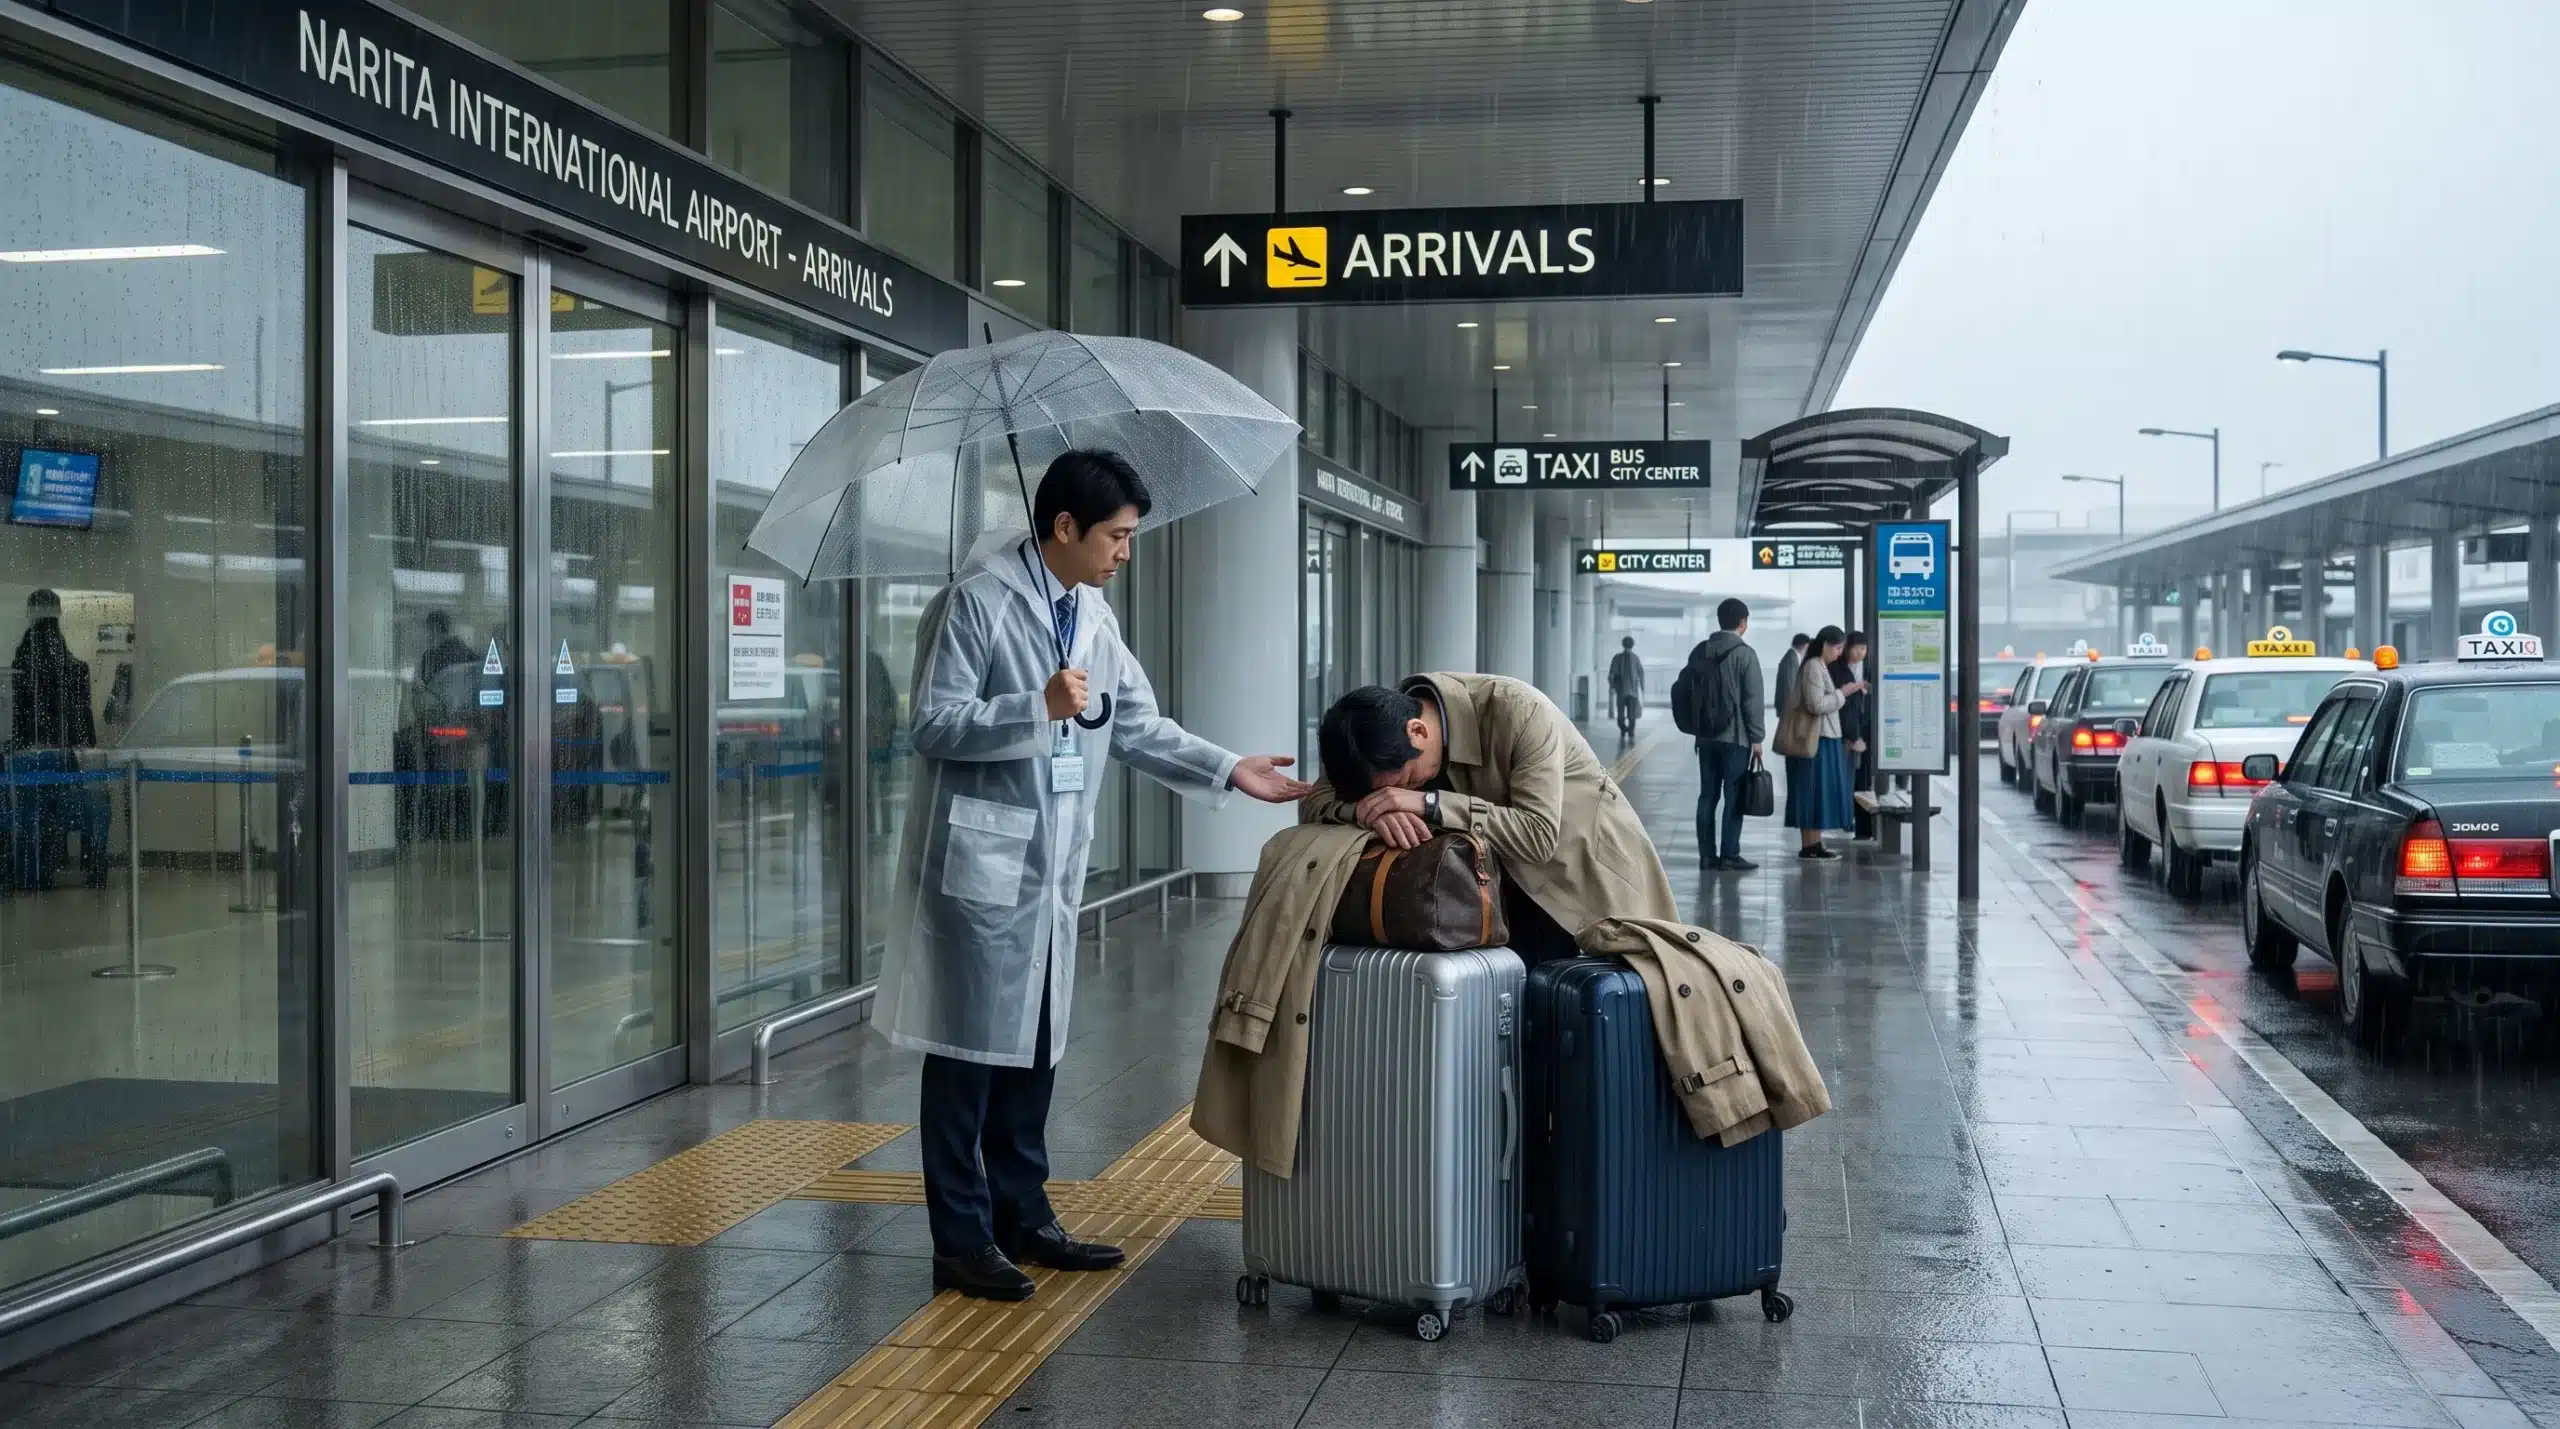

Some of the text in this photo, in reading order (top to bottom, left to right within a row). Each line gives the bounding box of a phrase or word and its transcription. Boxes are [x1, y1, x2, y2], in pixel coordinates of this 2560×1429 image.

[299, 9, 439, 129] NARITA
[450, 78, 680, 230] INTERNATIONAL
[685, 189, 783, 271] AIRPORT
[802, 242, 894, 318] ARRIVALS
[1342, 227, 1596, 279] ARRIVALS
[1533, 452, 1600, 480] TAXI
[1610, 448, 1645, 465] BUS
[1610, 466, 1700, 481] CITY CENTER
[1618, 553, 1706, 569] CITY CENTER
